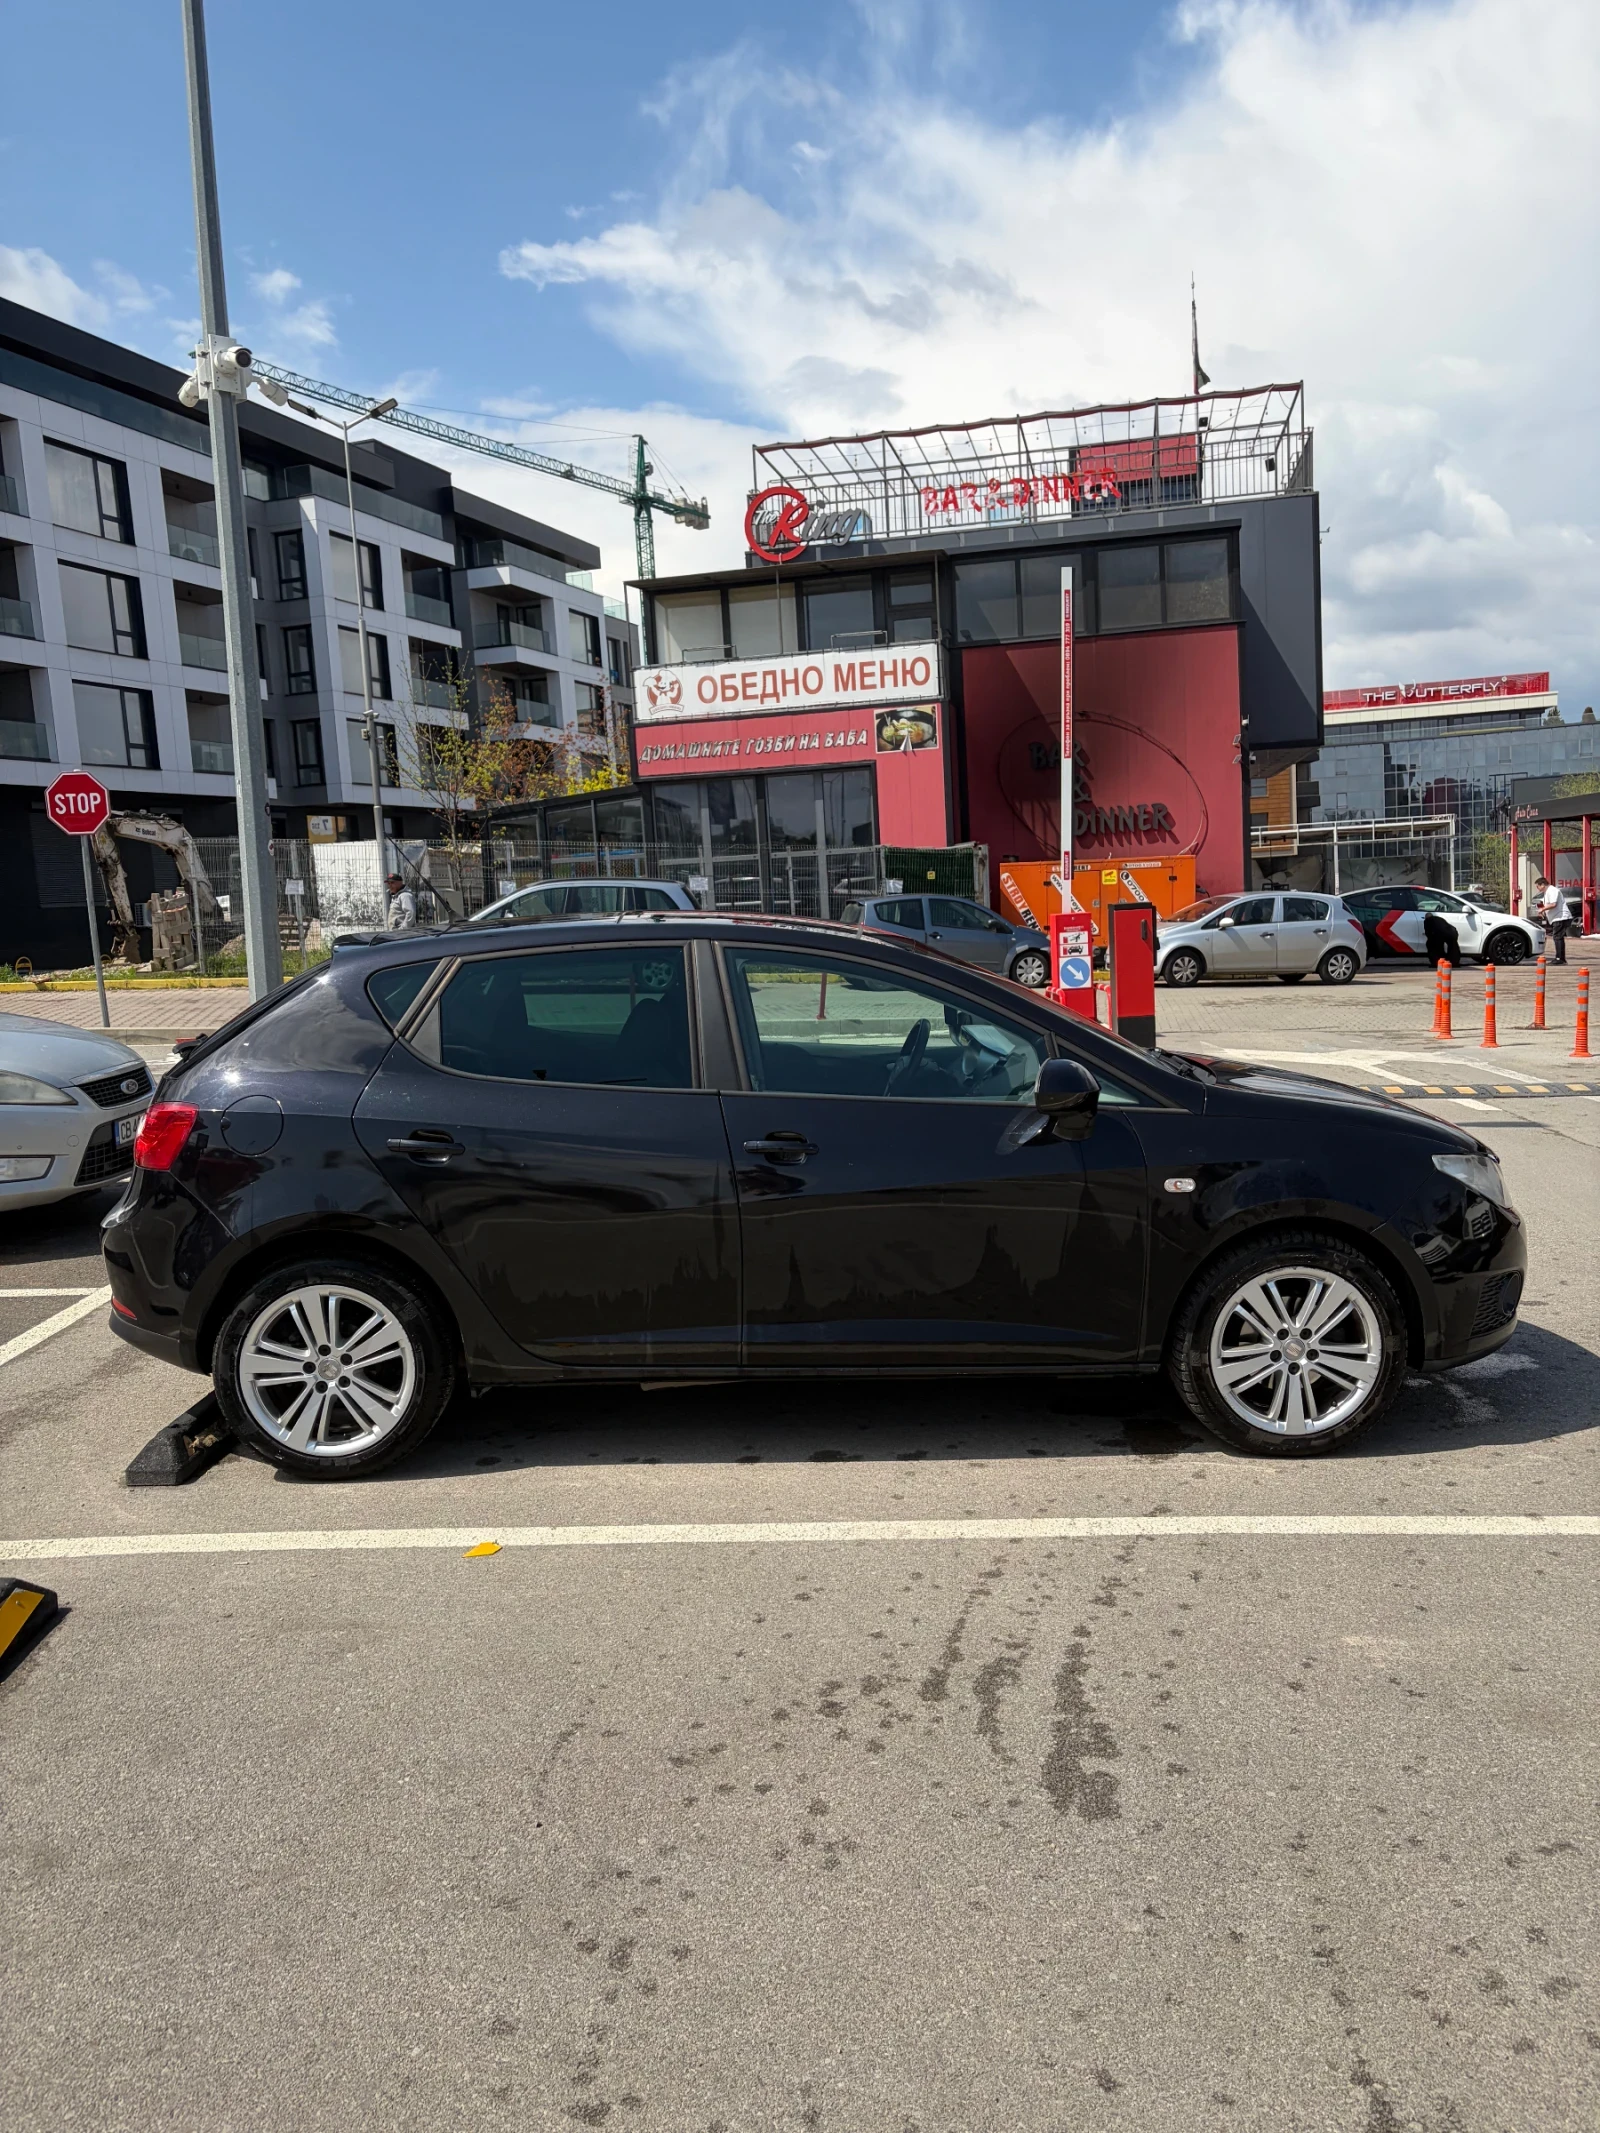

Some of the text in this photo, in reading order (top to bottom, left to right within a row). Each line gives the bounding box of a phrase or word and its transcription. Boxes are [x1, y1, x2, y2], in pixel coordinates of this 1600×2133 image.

[920, 482, 982, 516] BAR
[1009, 467, 1122, 507] DINNER
[755, 509, 780, 526] The
[768, 500, 862, 548] Ring
[697, 656, 931, 705] ОБЕДНО МЕНЮ
[1362, 691, 1396, 702] THE
[639, 729, 869, 764] ДОМАШНИТЕ ГОЗБИ НА БАБА
[54, 792, 102, 815] STOP
[1072, 802, 1173, 837] DINNER
[1126, 879, 1145, 901] 0700
